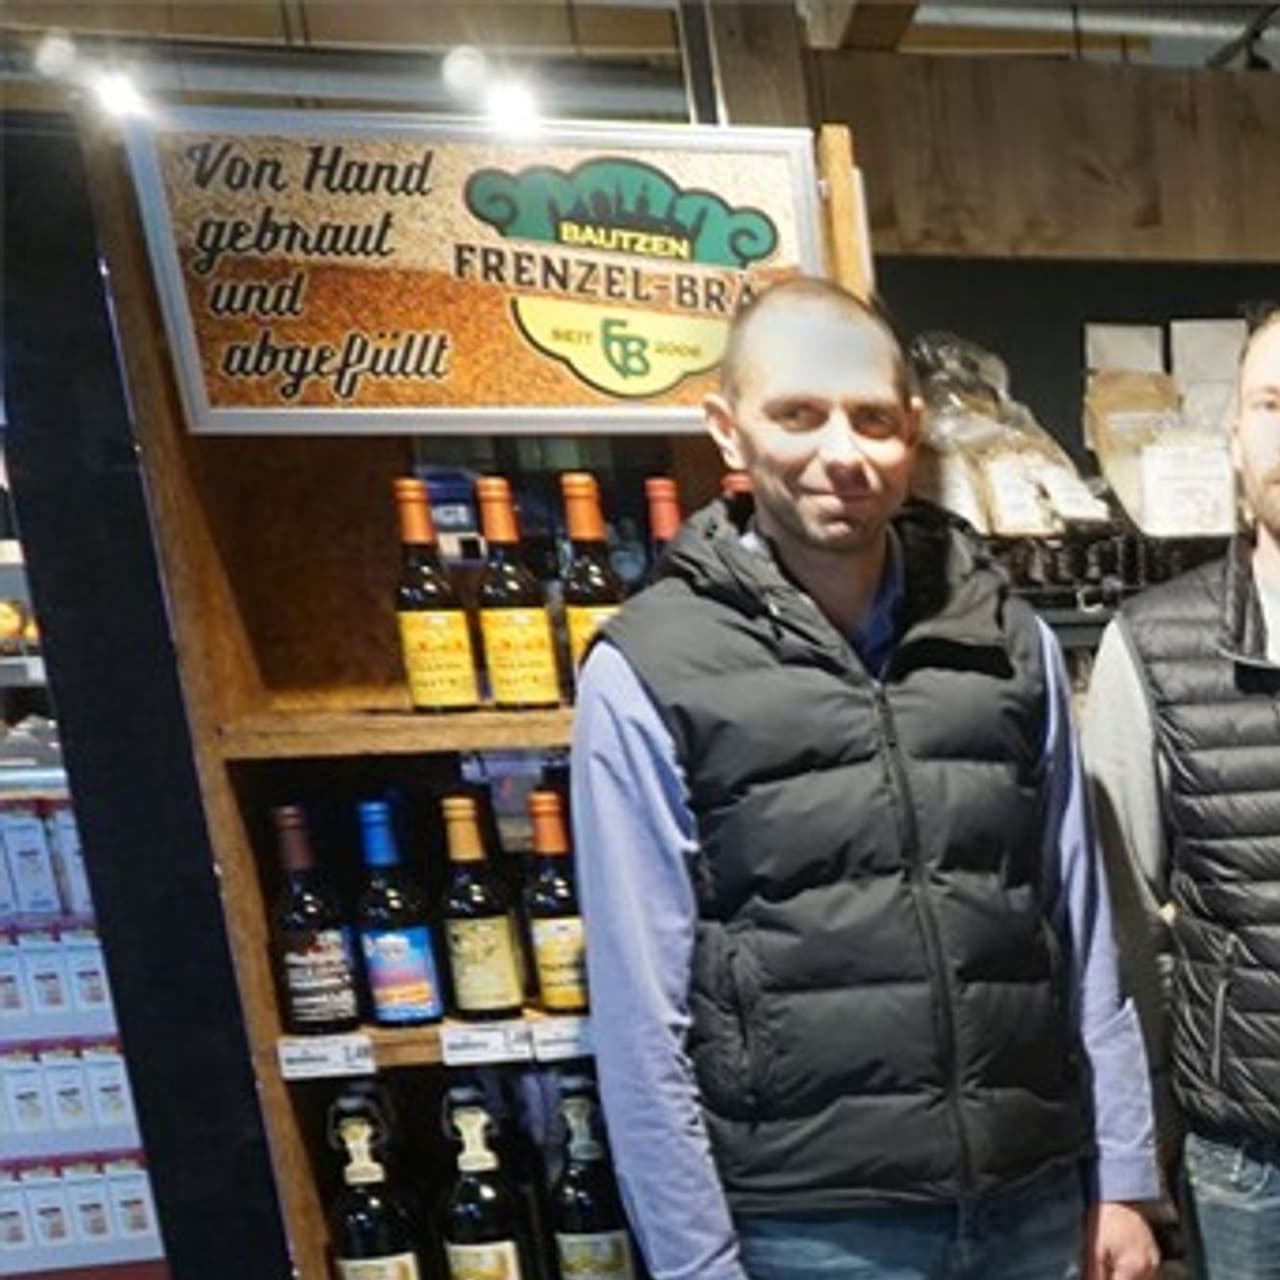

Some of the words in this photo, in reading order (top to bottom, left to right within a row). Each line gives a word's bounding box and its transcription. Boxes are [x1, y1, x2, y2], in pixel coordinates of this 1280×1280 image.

[187, 142, 289, 192] Von
[303, 145, 434, 197] Hand
[193, 206, 394, 275] gebraut
[560, 221, 691, 259] BAUTZEN
[210, 273, 305, 317] und
[453, 243, 757, 313] FRENZEL-BRÄ
[223, 330, 449, 399] abgefüllt
